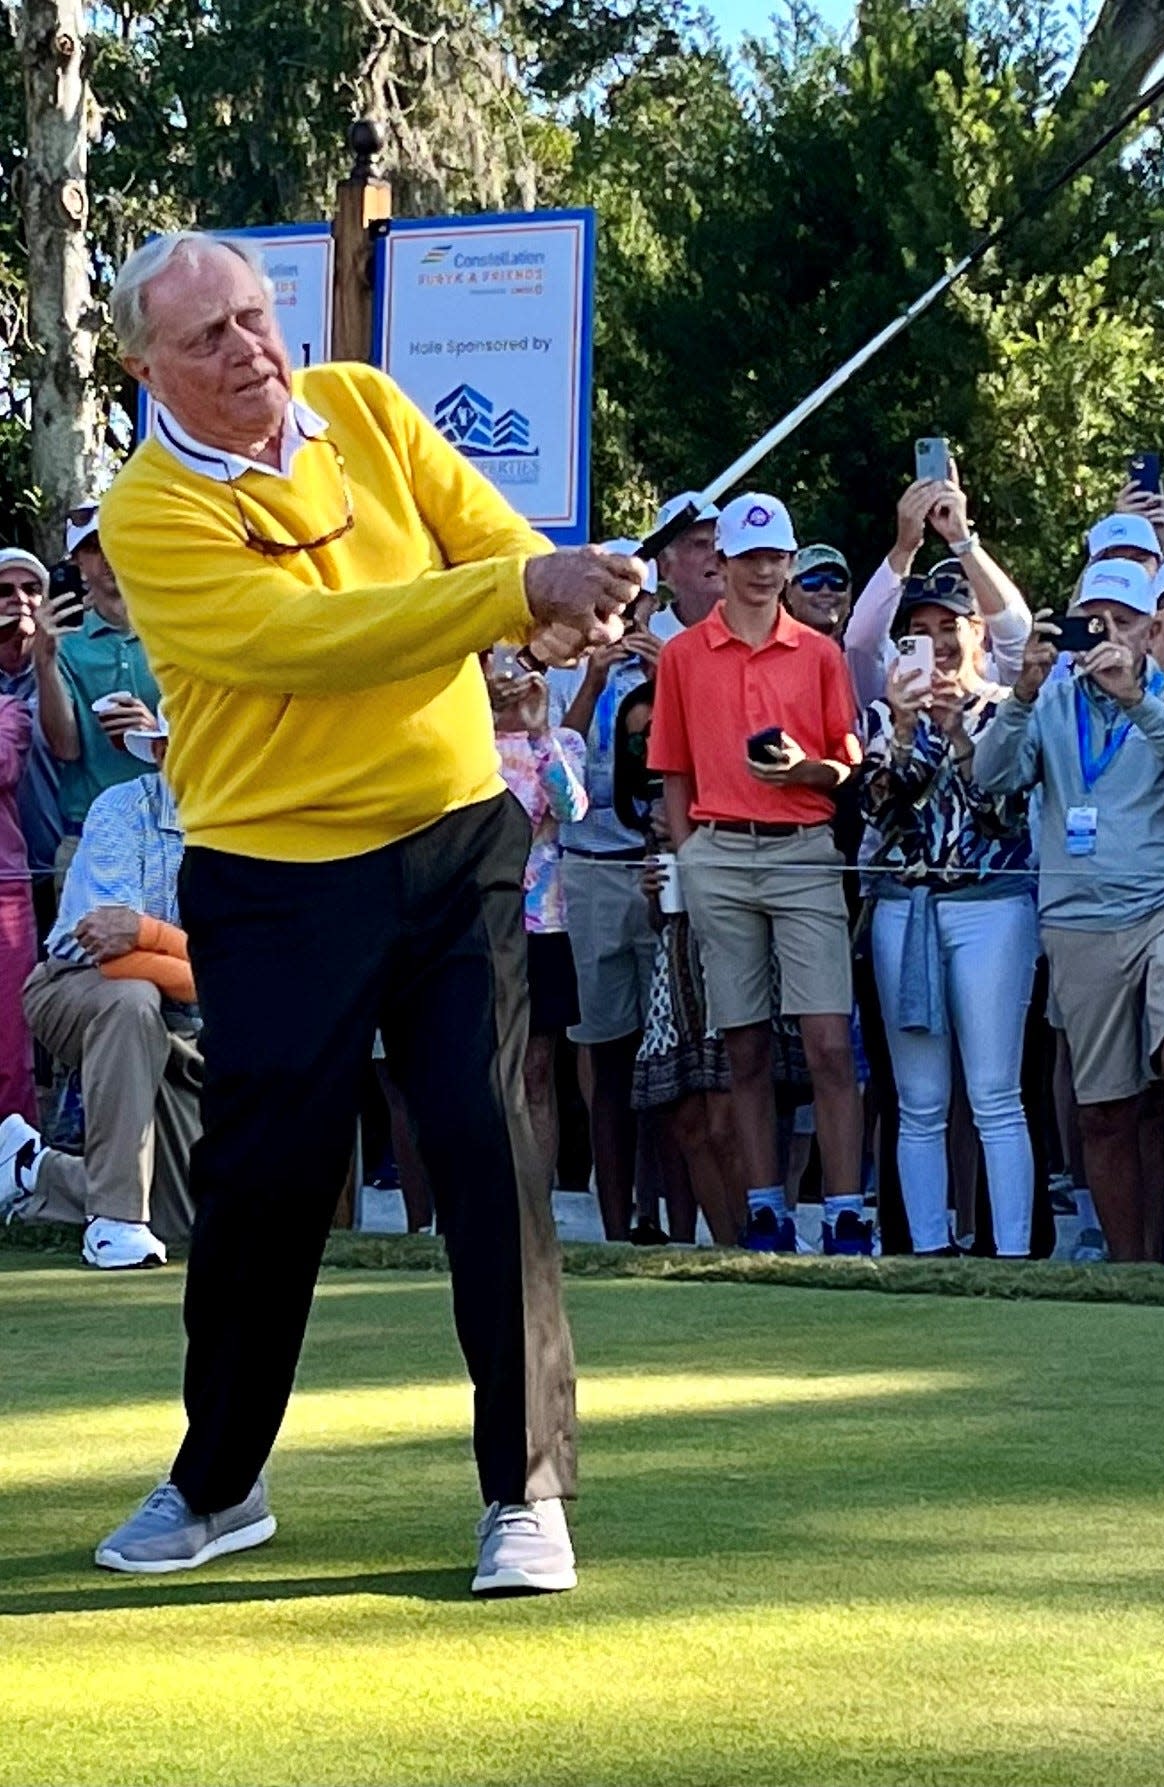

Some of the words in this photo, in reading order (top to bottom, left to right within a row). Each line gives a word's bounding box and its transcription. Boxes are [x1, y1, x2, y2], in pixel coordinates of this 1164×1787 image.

[454, 250, 545, 268] Constellation
[409, 340, 442, 355] Hole
[446, 335, 529, 357] Sponsored
[533, 332, 552, 353] by
